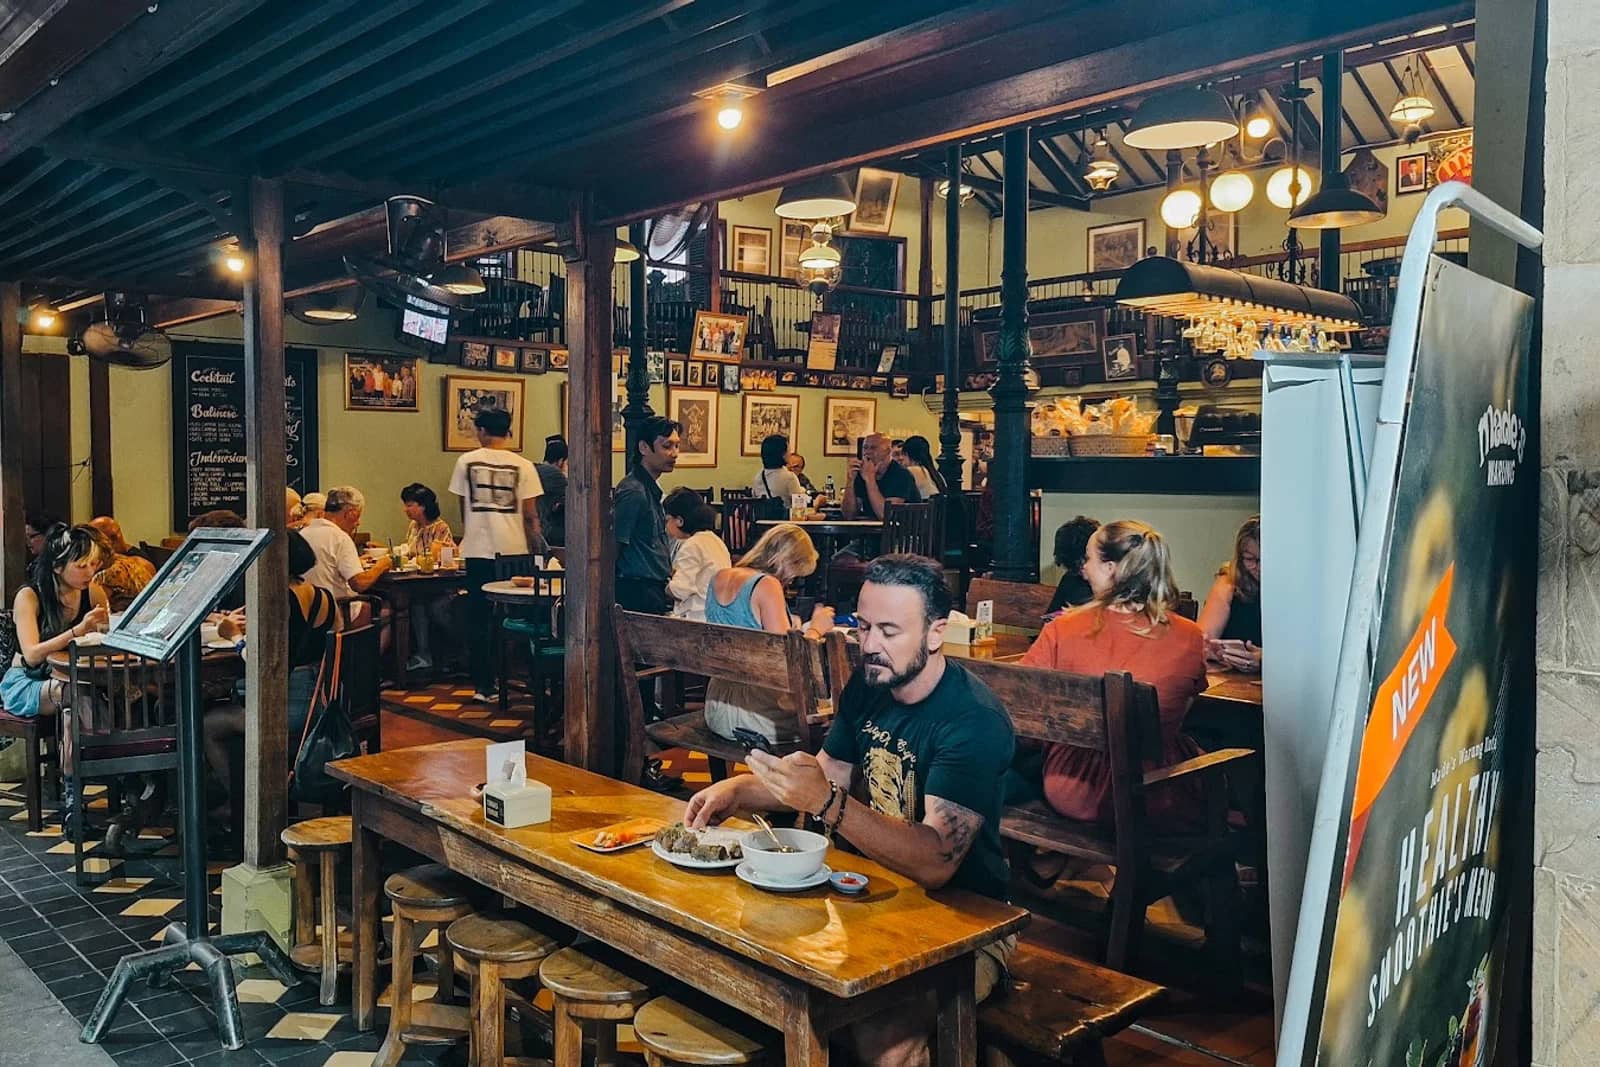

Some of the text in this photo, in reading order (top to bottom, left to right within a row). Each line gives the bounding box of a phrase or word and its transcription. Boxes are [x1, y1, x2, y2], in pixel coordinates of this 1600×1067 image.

[191, 370, 237, 384] Cocktail
[191, 403, 239, 419] Balinese
[1392, 615, 1436, 741] NEW
[1395, 770, 1500, 928] HEALTHY
[1367, 866, 1496, 1029] SMOOTHIE'S MENU
